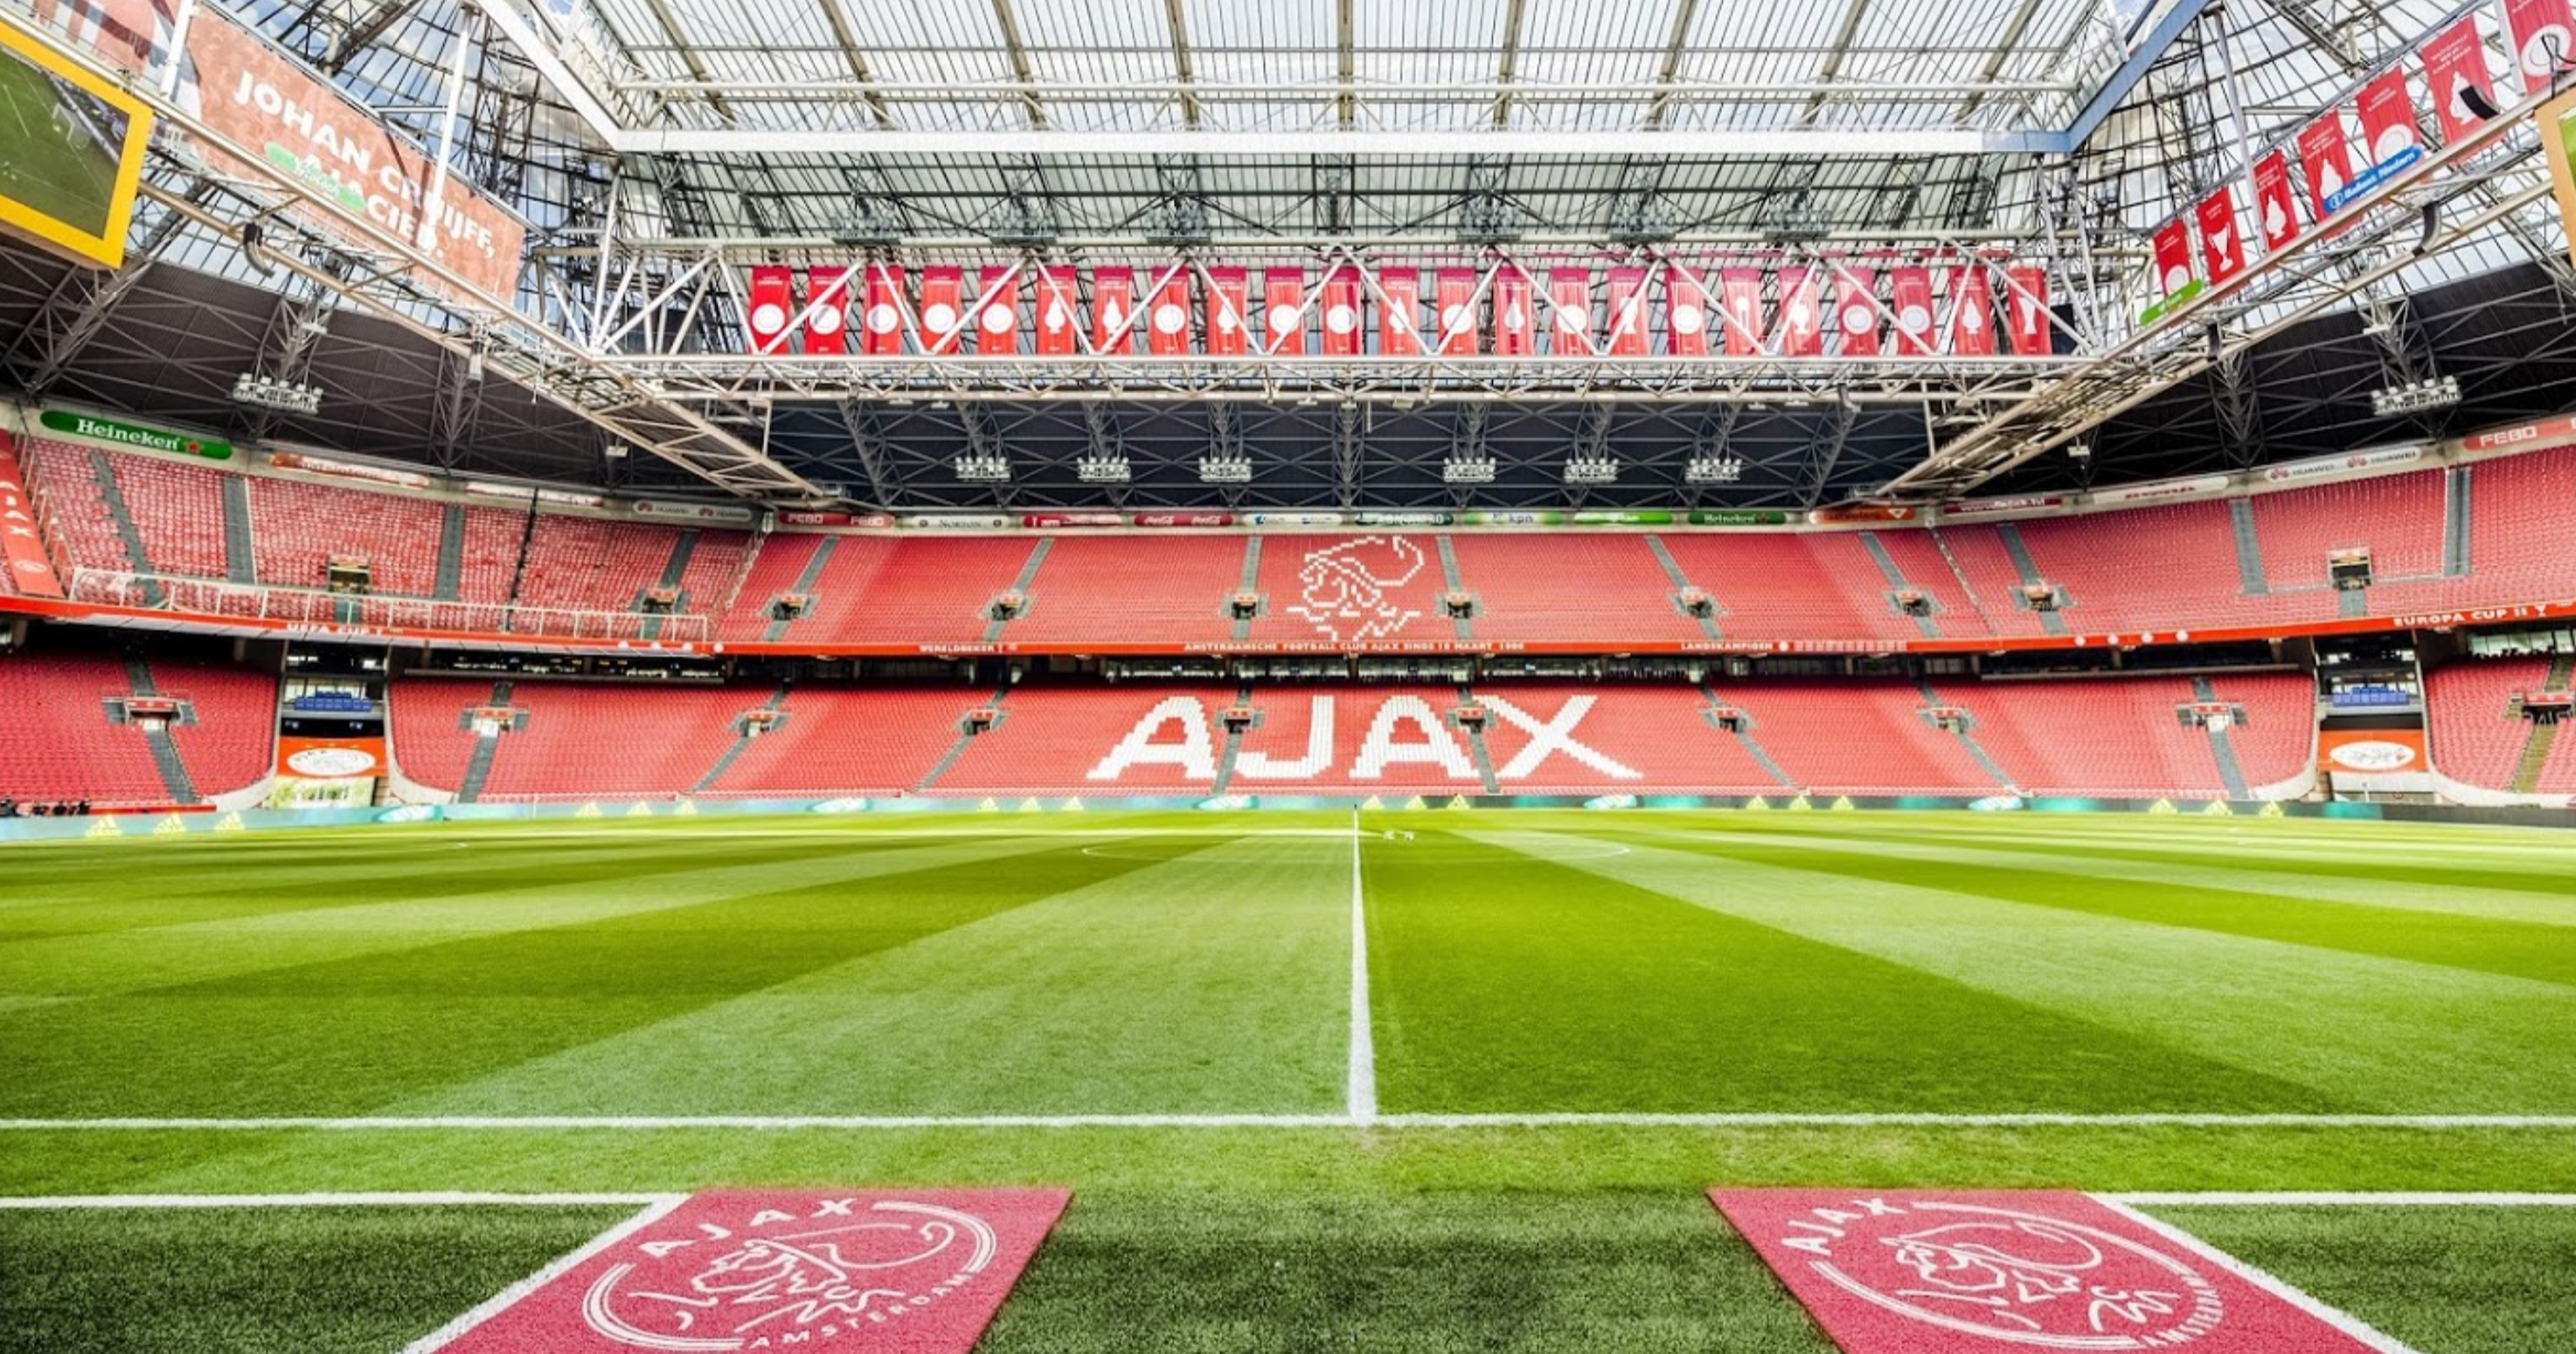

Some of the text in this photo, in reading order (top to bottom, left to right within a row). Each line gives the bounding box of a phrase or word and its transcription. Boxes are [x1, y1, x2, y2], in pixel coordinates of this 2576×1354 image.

[233, 70, 371, 174] JOHAN
[77, 419, 177, 450] Heineken
[2480, 426, 2537, 448] FEBO
[788, 513, 823, 524] FEBO
[1704, 513, 1756, 524] Heineken
[2393, 613, 2466, 627] EUROPA
[2471, 609, 2508, 620] CUP
[1184, 642, 1277, 651] AMSTERDAMSCHE
[1283, 642, 1335, 651] FOOTBALL
[1340, 642, 1368, 651] CLUB
[1371, 642, 1399, 651] AJAX
[1404, 642, 1434, 651] SINDS
[1455, 642, 1492, 651] MAART
[1680, 642, 1774, 651] LANDSKAMPIOEN
[1087, 694, 1644, 780] AJAX
[638, 1198, 857, 1258] AJAX
[1781, 1198, 1909, 1256] AJAX
[748, 1273, 972, 1349] AMSTERDAM
[2141, 1276, 2224, 1347] AMSTERDAM
